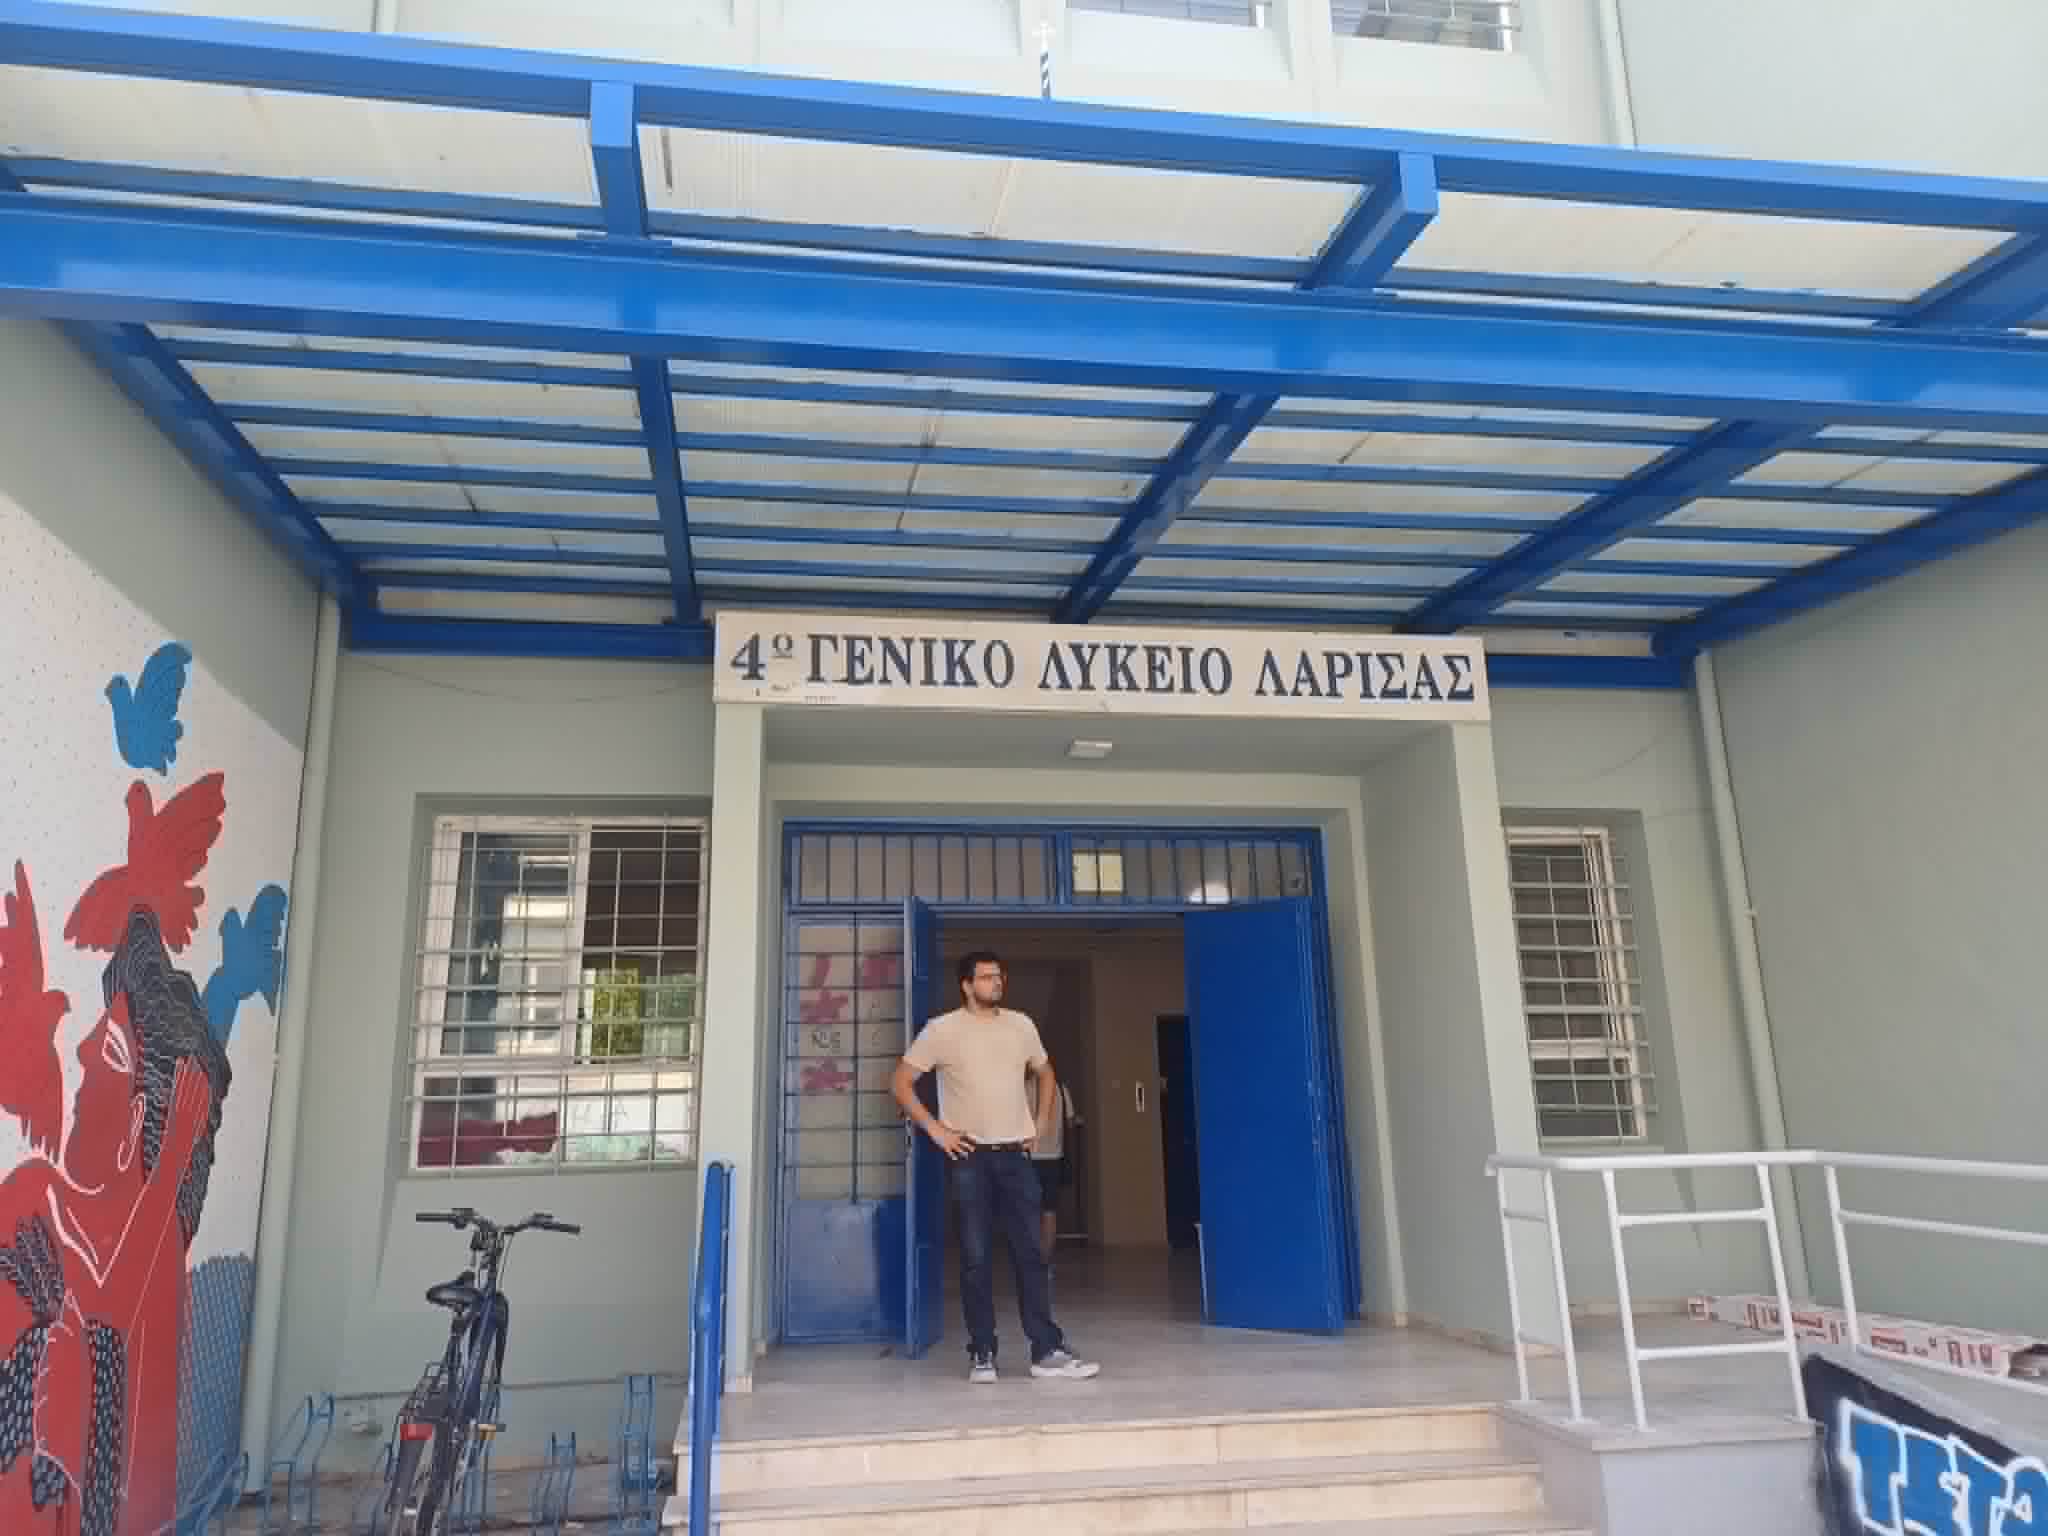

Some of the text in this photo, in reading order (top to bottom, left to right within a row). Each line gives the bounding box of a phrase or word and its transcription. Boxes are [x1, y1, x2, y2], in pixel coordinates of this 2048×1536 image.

[806, 633, 1015, 688] ΓΕΝΙΚΟ
[1037, 640, 1233, 695] ΛΥΚΕΙΟ
[1255, 649, 1475, 701] ΛΑΡΙΣΑΣ
